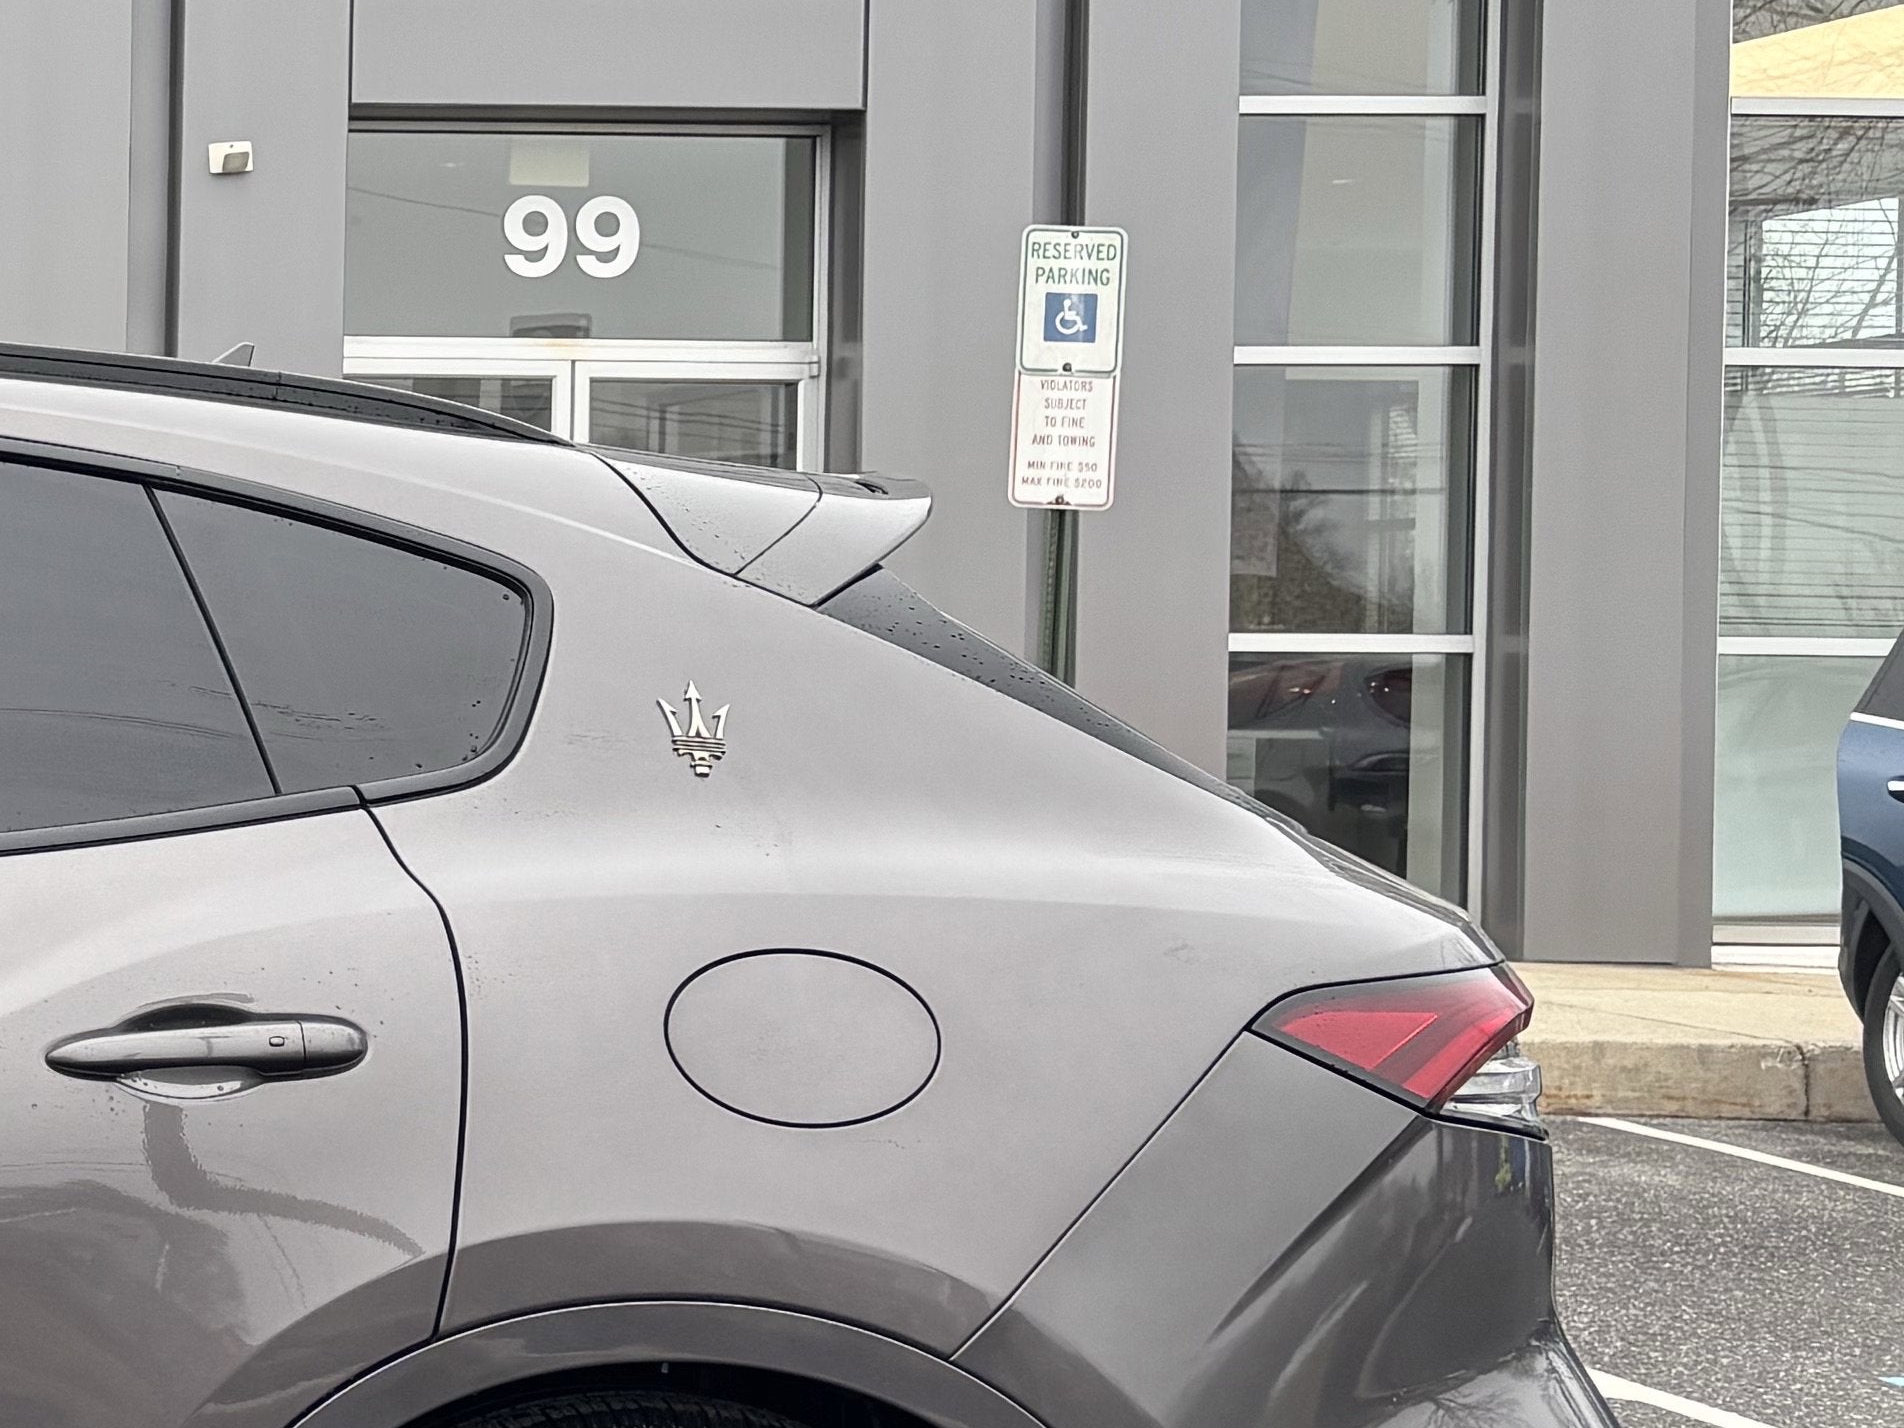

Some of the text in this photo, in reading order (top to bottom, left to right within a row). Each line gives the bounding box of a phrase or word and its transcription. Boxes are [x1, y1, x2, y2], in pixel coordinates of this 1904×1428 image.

[503, 194, 641, 279] 99
[1031, 241, 1117, 261] RESERVED
[1035, 266, 1111, 286] PARKING
[1040, 379, 1094, 392] VIOLATORS
[1044, 397, 1087, 410] SUBJECT
[1045, 415, 1086, 429] TO FINE
[1032, 433, 1096, 448] AND TOWING
[1027, 460, 1046, 470] MIN
